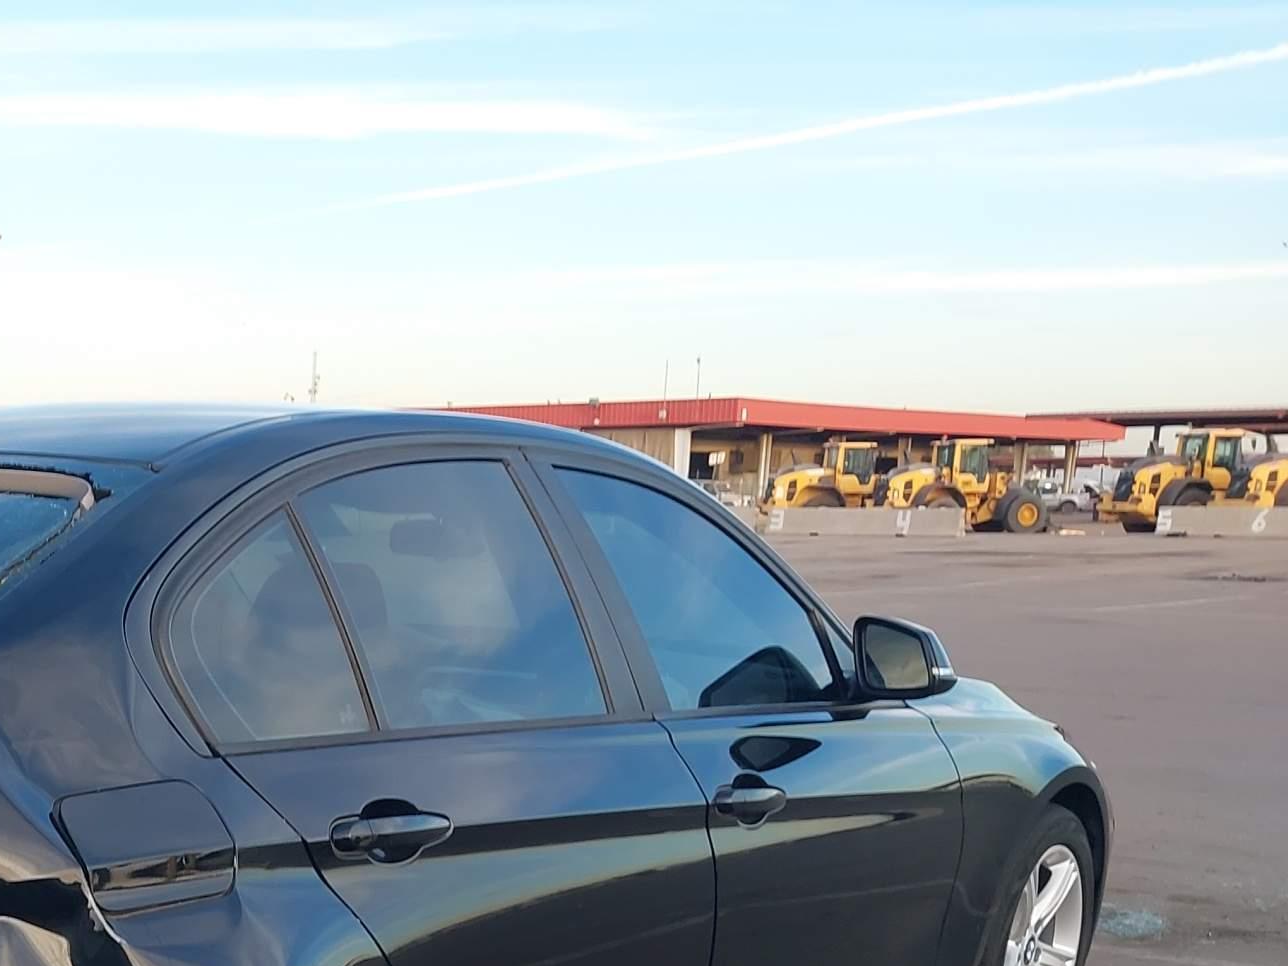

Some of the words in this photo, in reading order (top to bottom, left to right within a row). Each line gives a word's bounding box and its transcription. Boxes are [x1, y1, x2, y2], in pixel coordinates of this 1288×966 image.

[769, 509, 784, 529] 3
[896, 509, 911, 535] 4
[1251, 508, 1270, 533] 6
